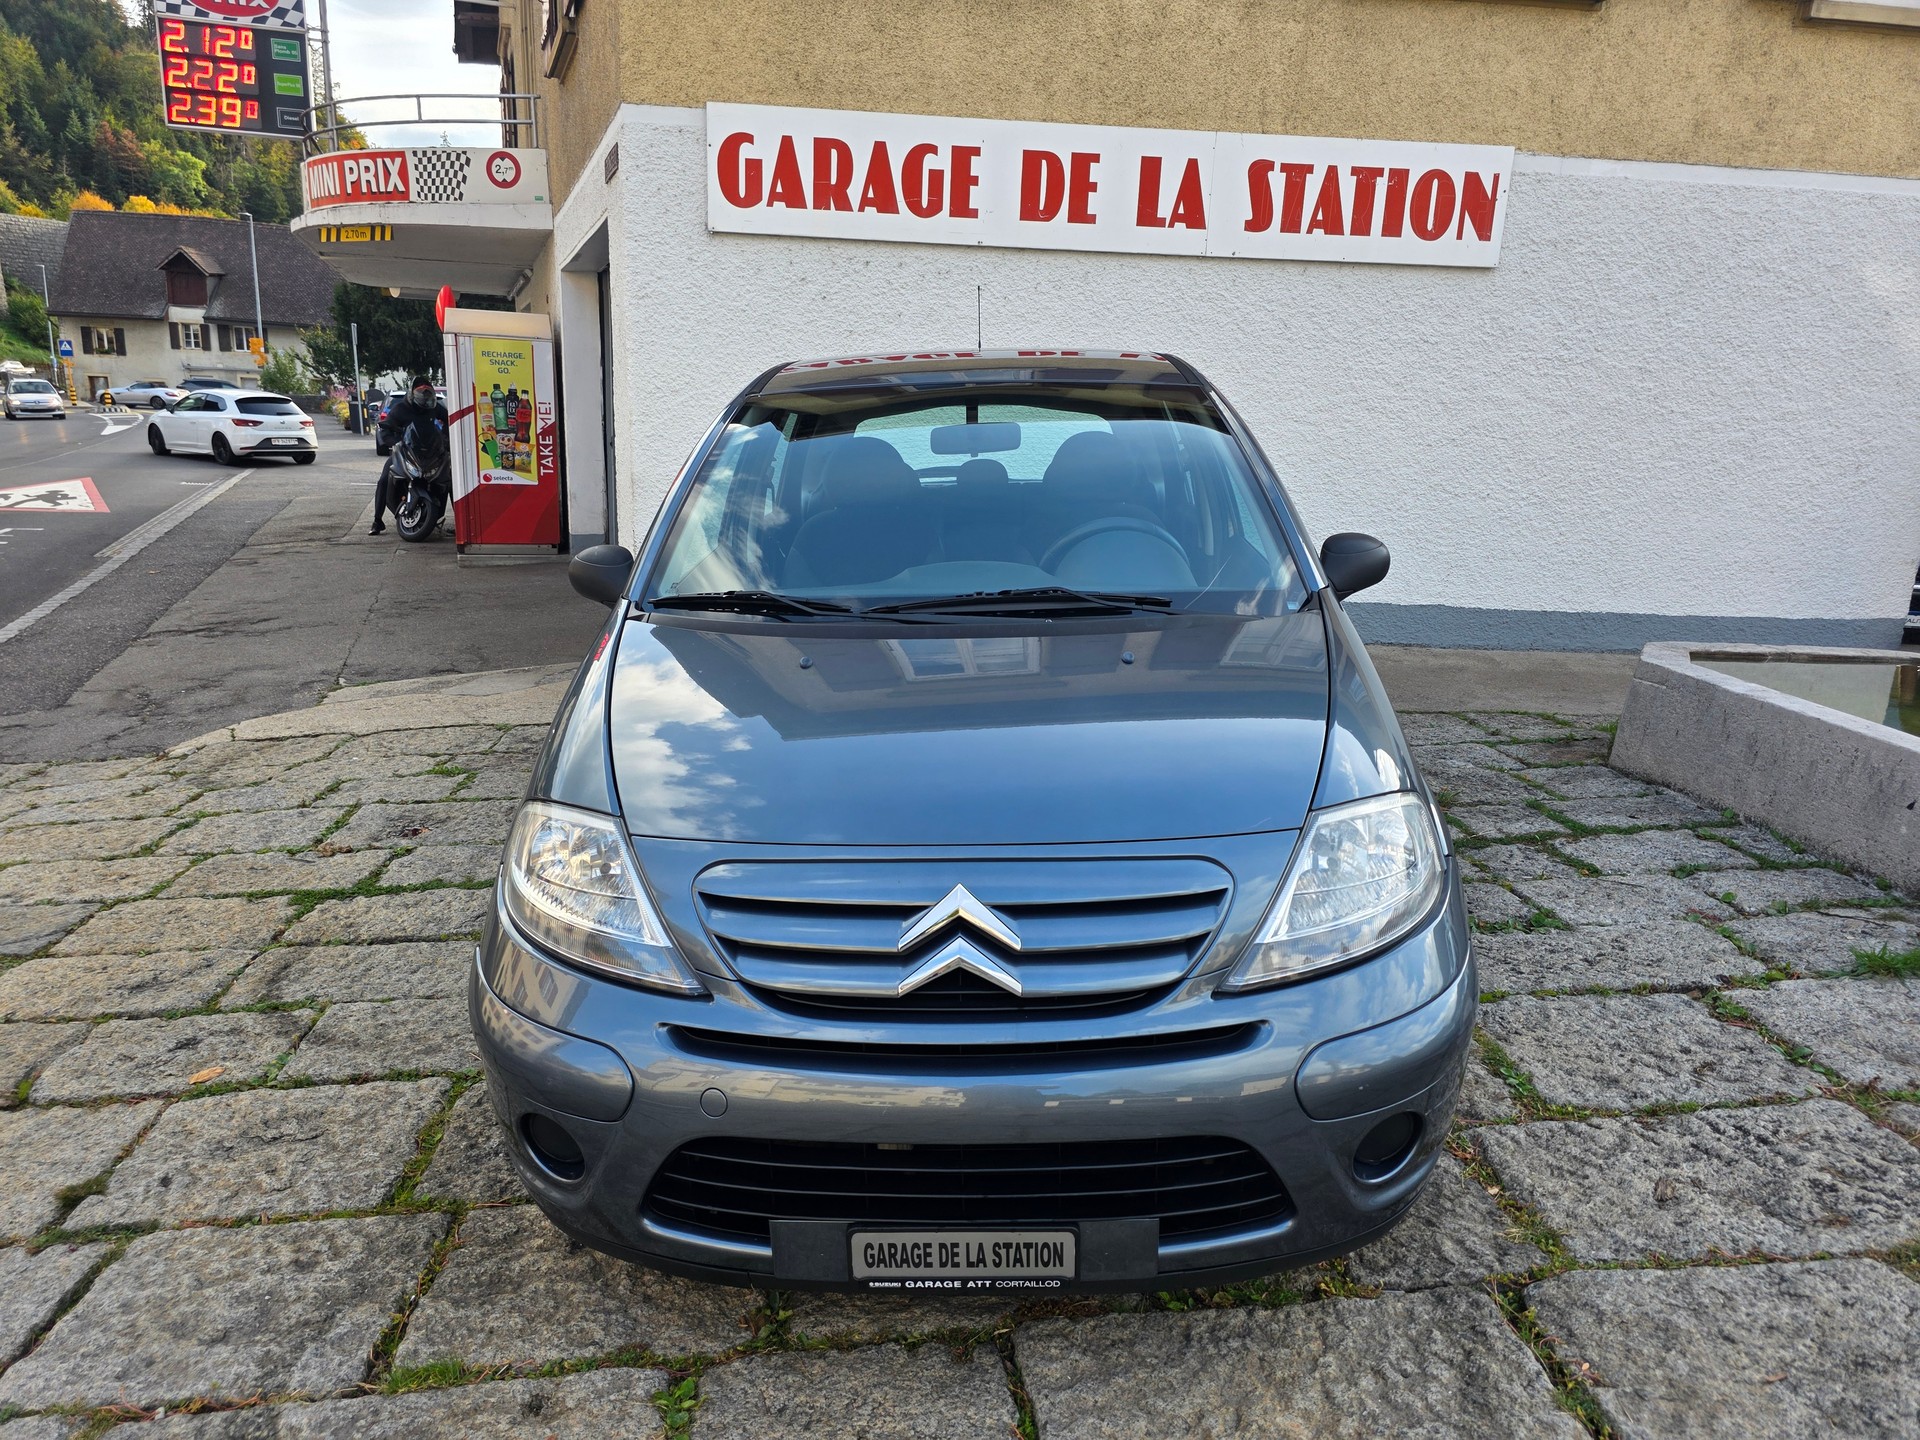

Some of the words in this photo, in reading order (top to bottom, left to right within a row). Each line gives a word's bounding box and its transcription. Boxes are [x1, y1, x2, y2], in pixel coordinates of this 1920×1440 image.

[309, 161, 340, 199] MINI
[344, 158, 406, 195] PRIX
[717, 132, 982, 219] GARAGE
[1019, 149, 1101, 225] DE
[1136, 156, 1207, 230] LA
[1244, 159, 1501, 242] STATION
[481, 351, 526, 359] RECHARGE.
[538, 401, 552, 433] ME!
[540, 435, 554, 477] TAKE
[863, 1242, 934, 1269] GARAGE
[938, 1242, 961, 1268] DE
[965, 1242, 988, 1268] LA
[992, 1241, 1065, 1269] STATION
[905, 1280, 962, 1288] GARAGE
[967, 1280, 992, 1288] ATT
[995, 1280, 1061, 1288] CORTAILLOD
